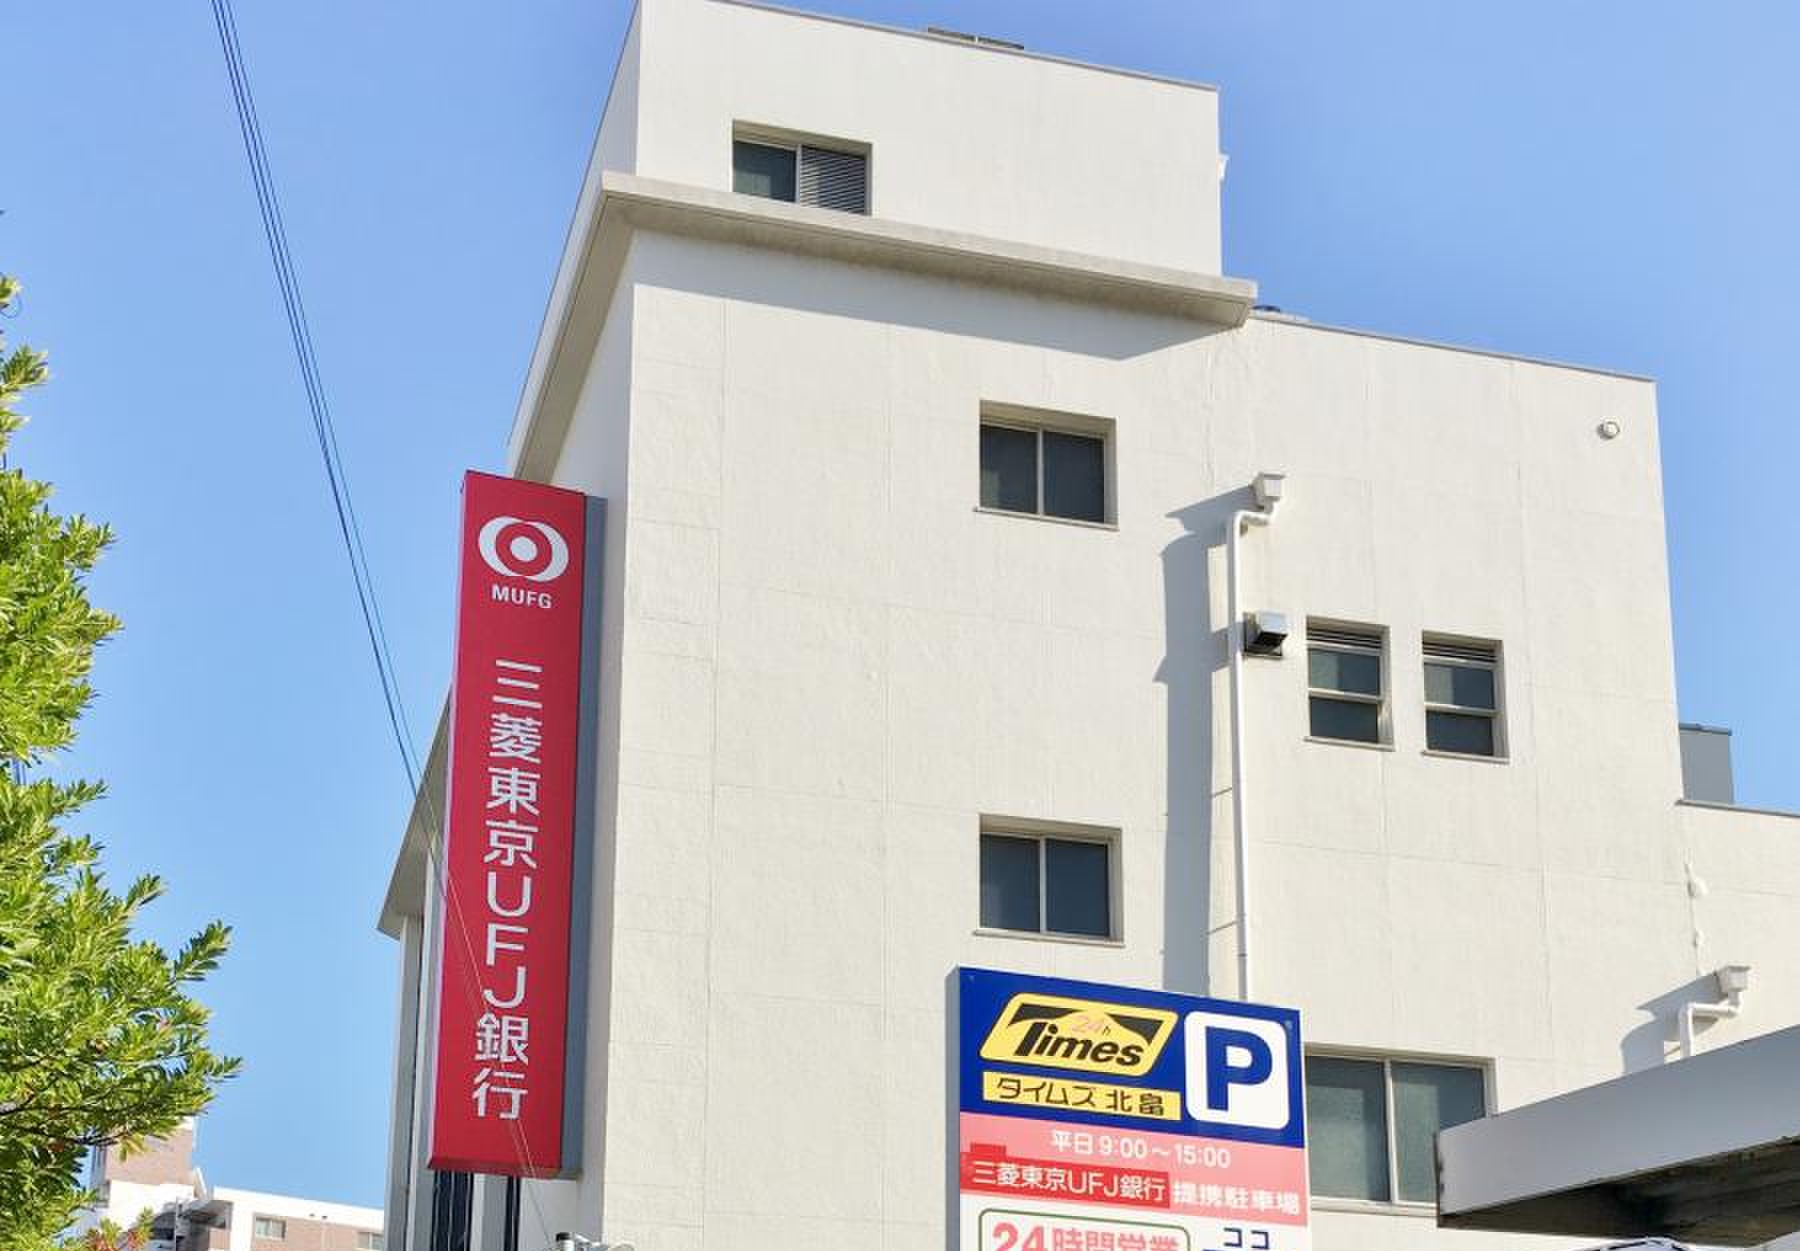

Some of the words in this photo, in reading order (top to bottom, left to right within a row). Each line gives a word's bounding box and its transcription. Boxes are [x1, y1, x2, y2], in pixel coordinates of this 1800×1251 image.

[491, 584, 553, 609] MUFG
[471, 656, 544, 1123] 三菱東京UFJ銀行
[1009, 1007, 1157, 1067] Times
[1205, 1024, 1273, 1112] P
[997, 1077, 1098, 1108] タイムズ
[972, 1160, 1167, 1202] 三菱東京UFJ銀行
[1223, 1226, 1270, 1250] ココ
